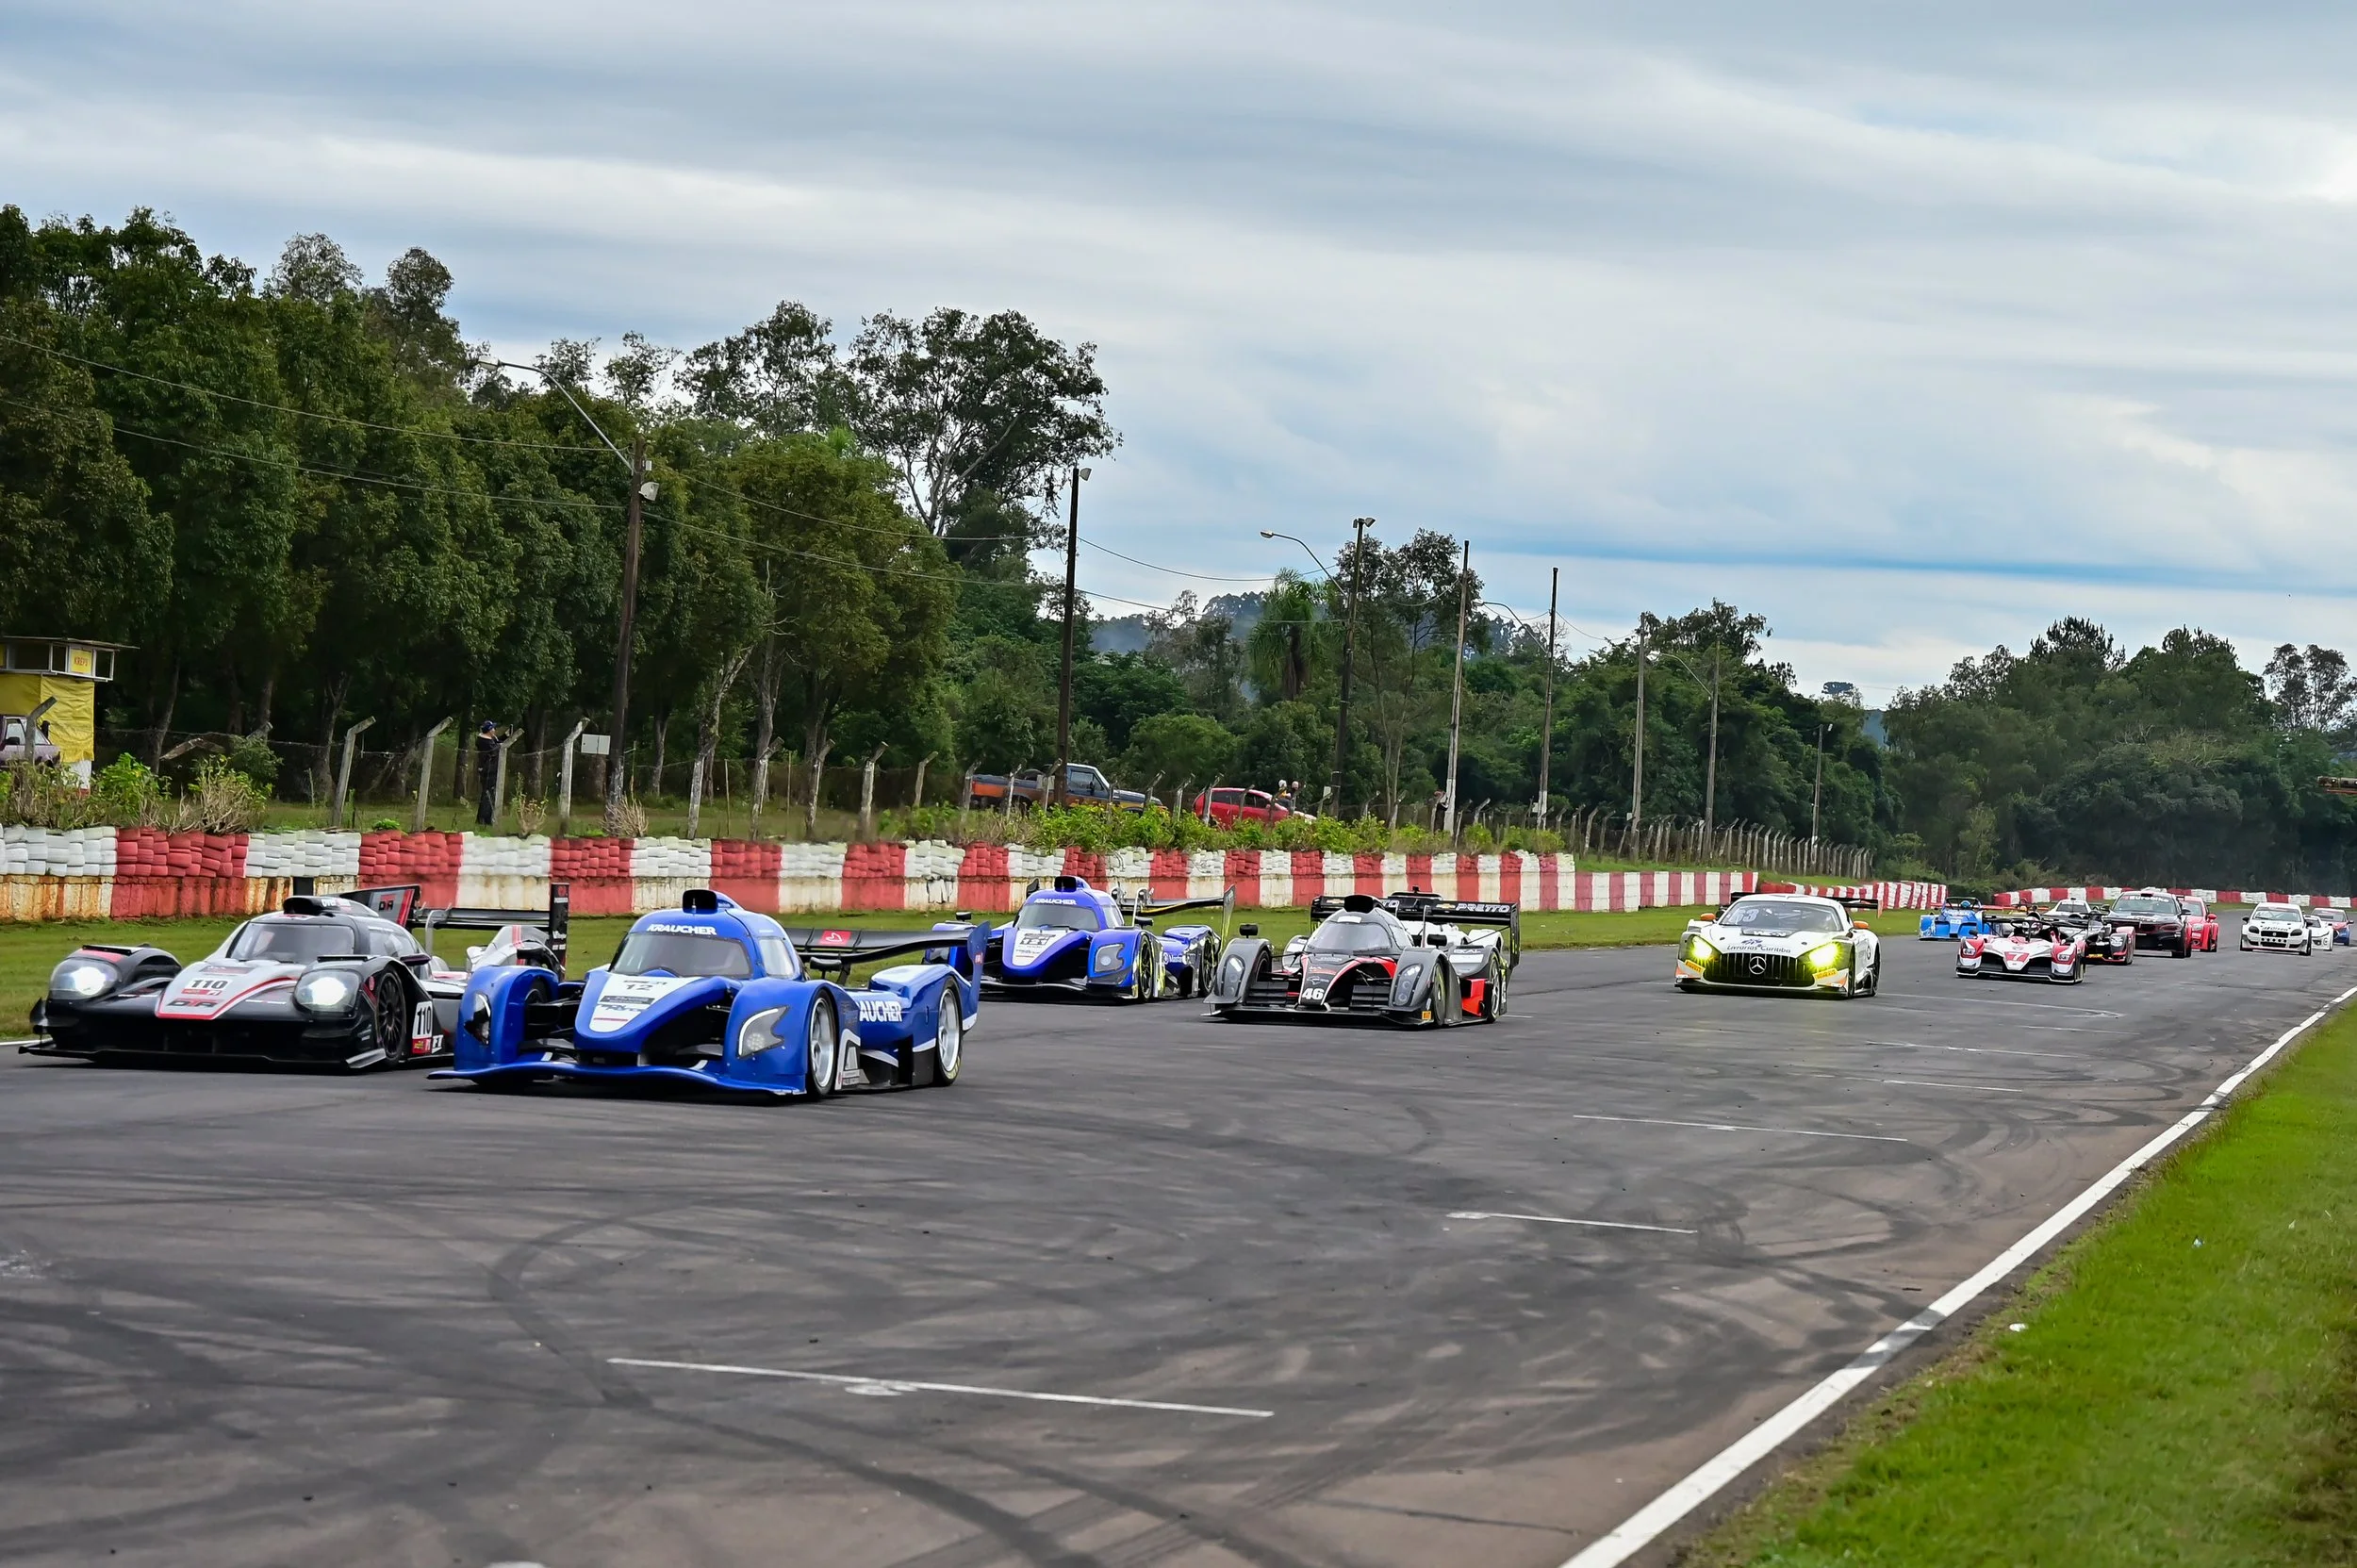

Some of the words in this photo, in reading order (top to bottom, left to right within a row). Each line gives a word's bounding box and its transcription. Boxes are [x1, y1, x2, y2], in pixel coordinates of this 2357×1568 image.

[1455, 902, 1510, 913] PRETTO
[646, 924, 717, 935] KRAUCHER
[191, 979, 229, 990] 110
[1302, 987, 1325, 1000] 46
[417, 1005, 432, 1036] 110
